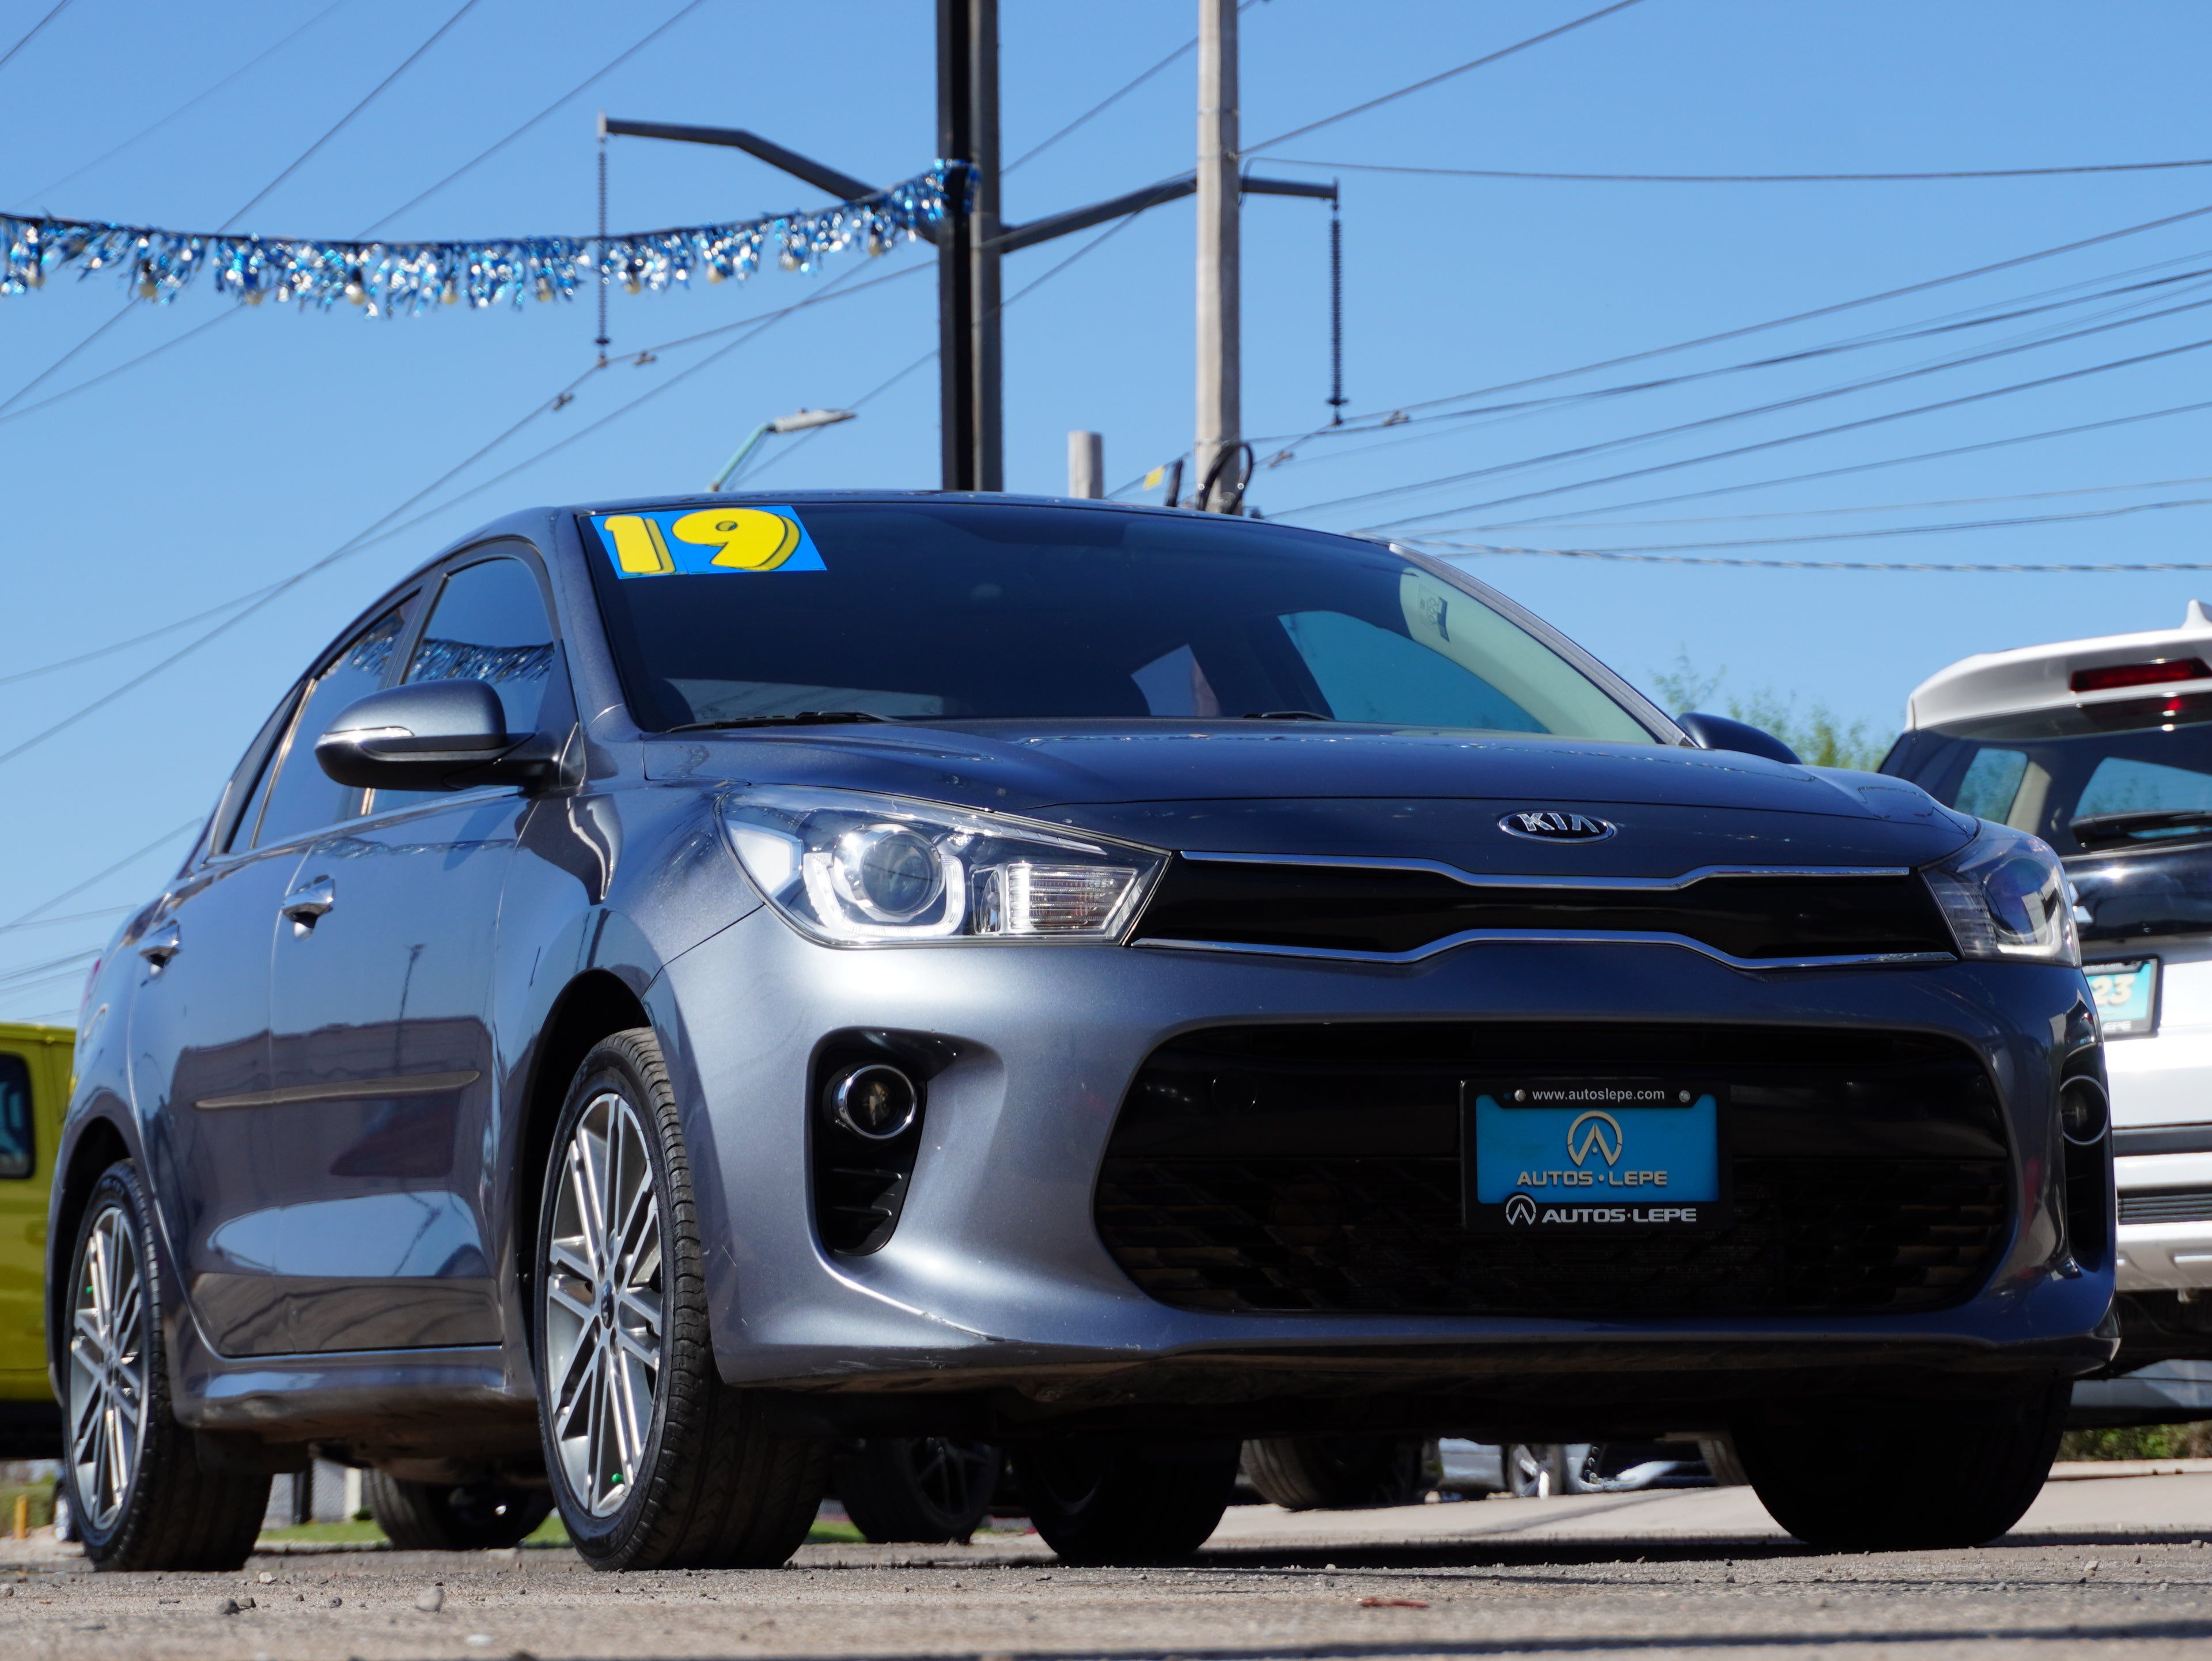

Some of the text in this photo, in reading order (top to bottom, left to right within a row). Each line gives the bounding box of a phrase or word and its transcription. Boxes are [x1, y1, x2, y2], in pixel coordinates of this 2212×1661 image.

[604, 508, 801, 574] 19
[1517, 813, 1600, 834] KIA
[2091, 974, 2135, 1007] 23
[1532, 1088, 1665, 1102] www.autoslepe.com
